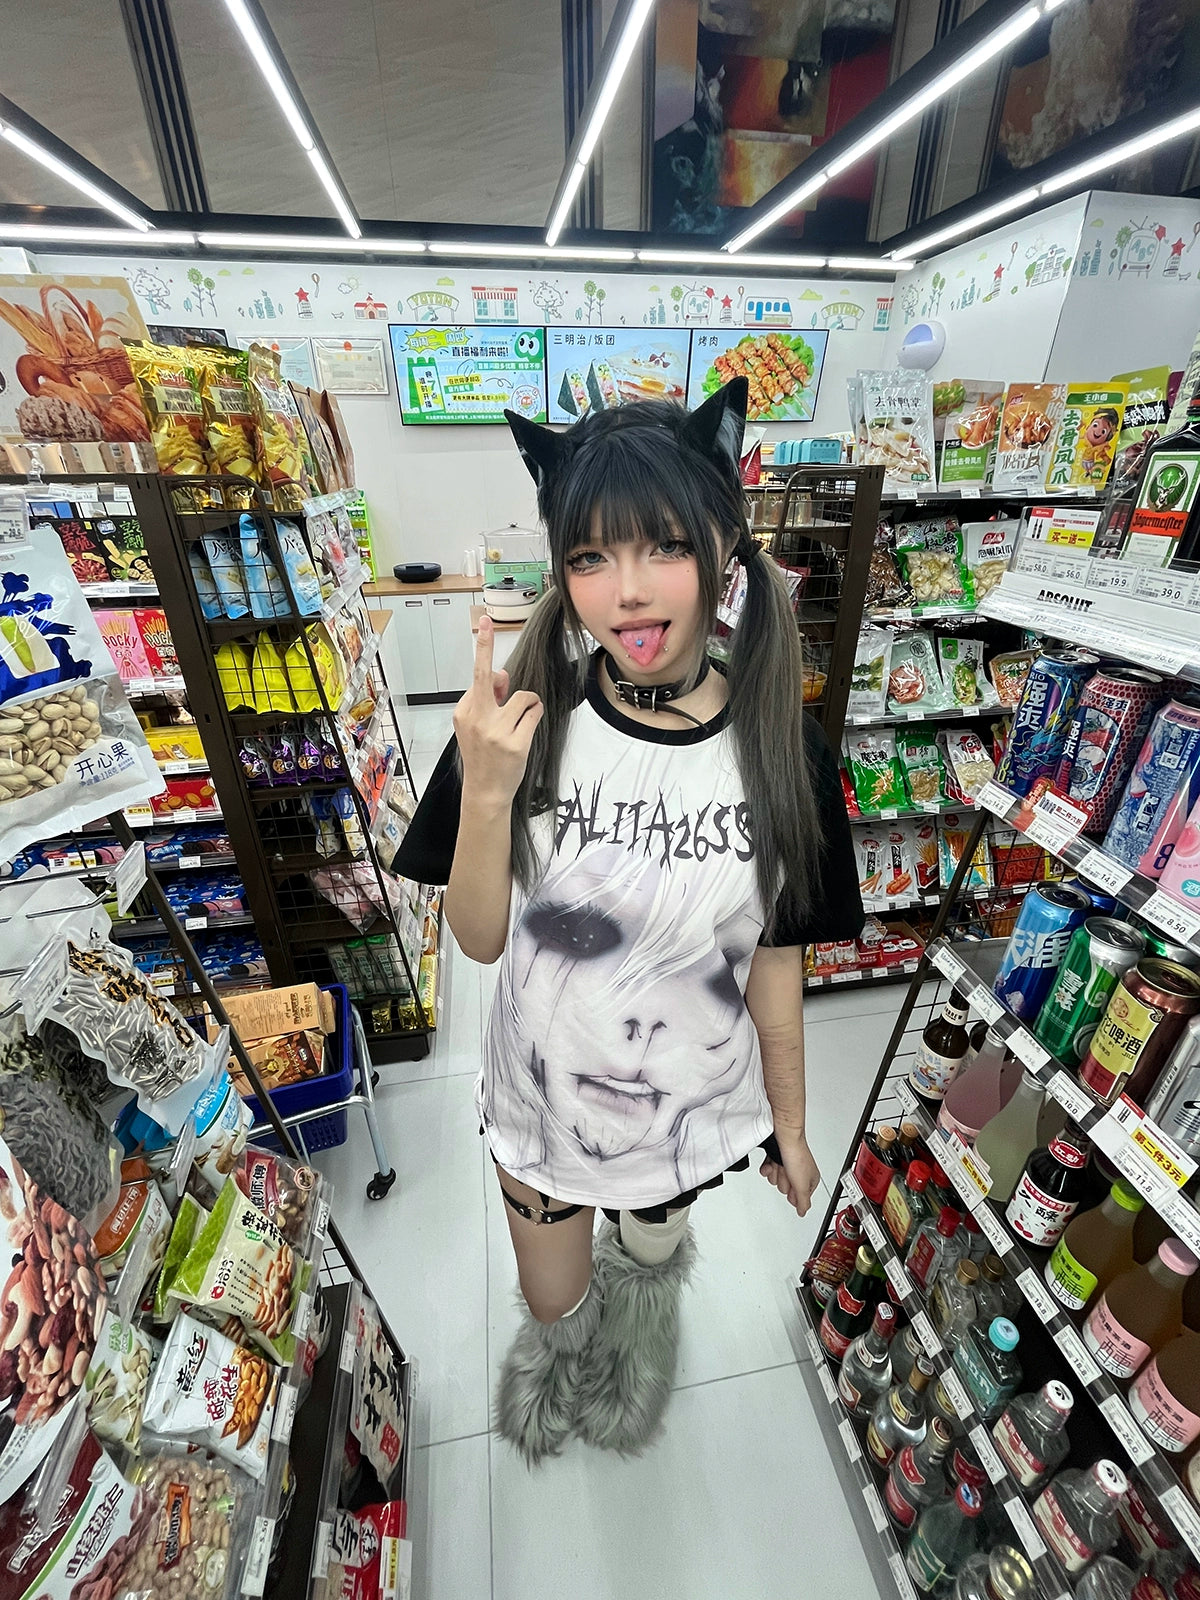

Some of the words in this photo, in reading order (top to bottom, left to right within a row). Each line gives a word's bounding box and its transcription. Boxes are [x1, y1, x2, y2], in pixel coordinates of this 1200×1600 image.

[554, 334, 615, 346] 三明治/饭团
[698, 335, 719, 346] 烤肉
[1051, 409, 1080, 484] 去骨凤爪
[1051, 531, 1086, 545] 买一送一
[1033, 563, 1047, 573] 58.0
[1065, 569, 1081, 579] 56.0
[1110, 577, 1127, 587] 19.9
[1160, 588, 1181, 600] 39.0
[1029, 672, 1045, 680] RIO
[1017, 681, 1049, 731] 强爽
[1062, 720, 1081, 759] 强爽
[74, 741, 129, 779] 开心果
[1100, 874, 1117, 887] 14.8
[1166, 918, 1187, 933] 8.50
[1055, 968, 1085, 1011] 雪花
[1134, 1131, 1184, 1182] 第二件3元
[1136, 1174, 1153, 1193] 11.8
[65, 1483, 124, 1578] 山核桃仁
